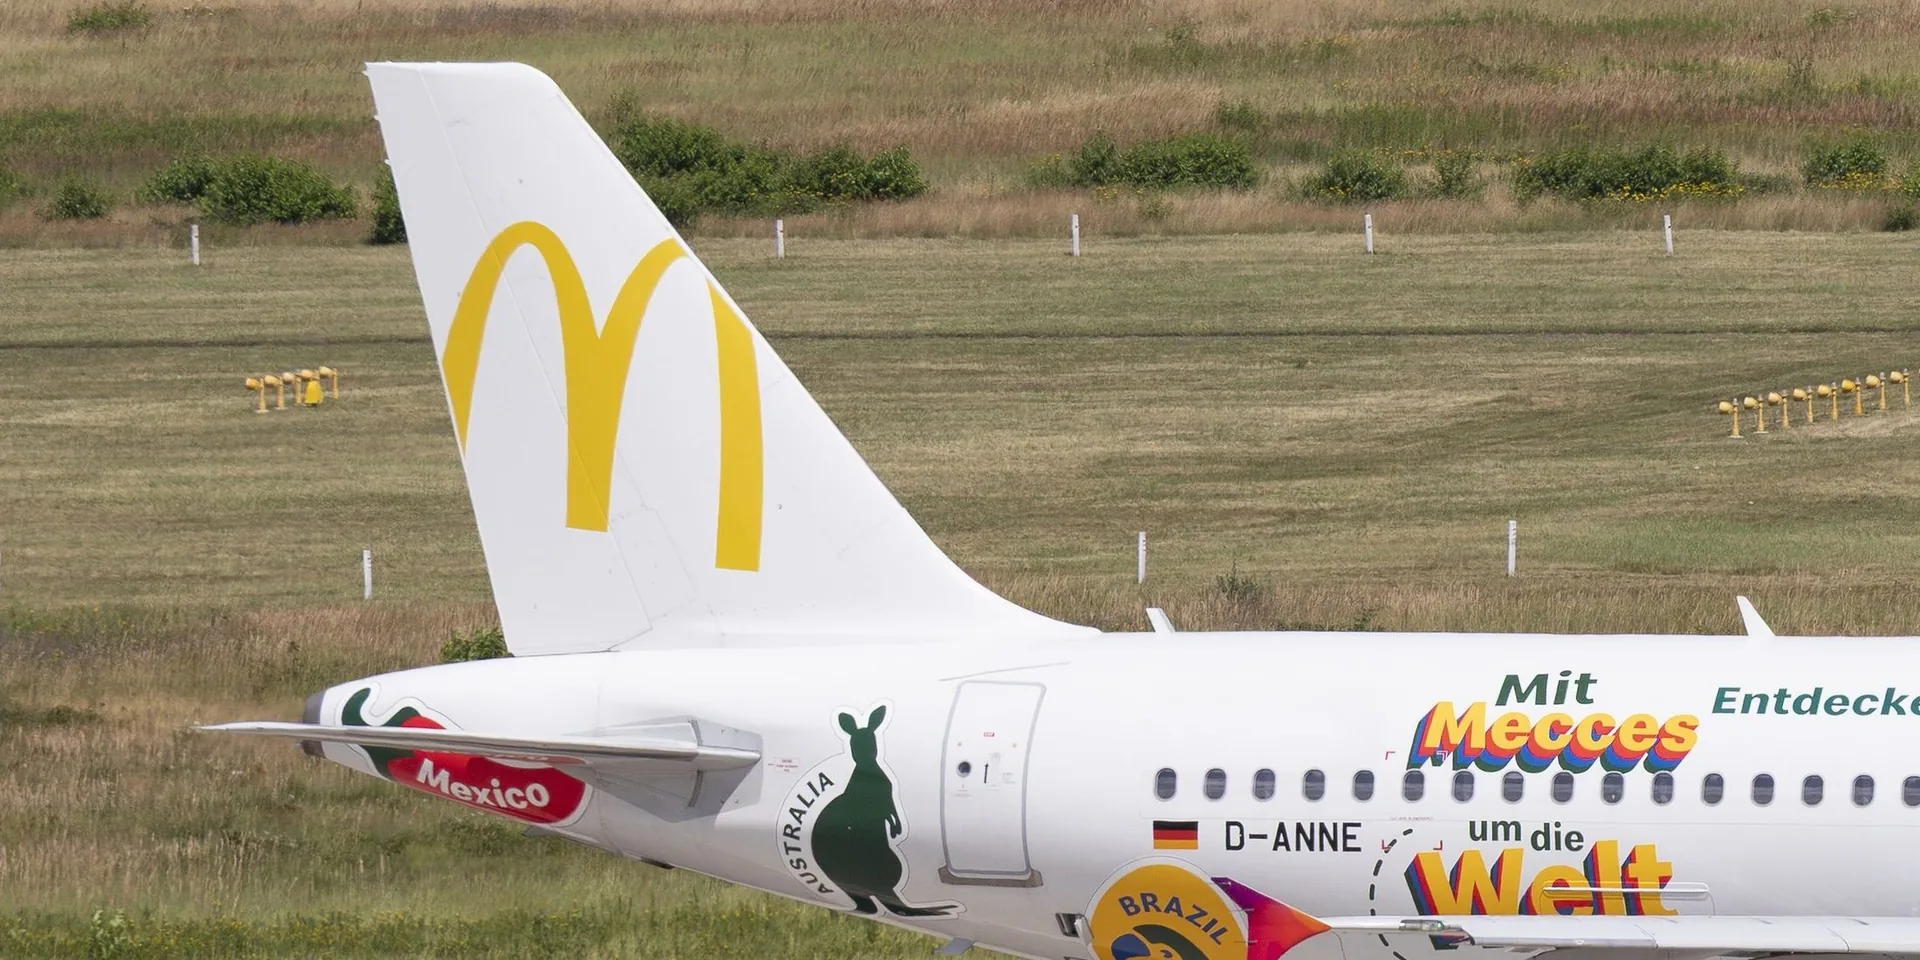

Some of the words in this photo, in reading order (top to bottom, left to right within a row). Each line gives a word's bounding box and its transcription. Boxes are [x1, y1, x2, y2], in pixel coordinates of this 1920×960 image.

[1495, 670, 1598, 706] Mit
[1406, 701, 1700, 774] Mecces
[416, 758, 550, 809] Mexico
[782, 772, 835, 894] AUSTRALIA
[1225, 821, 1362, 852] D-ANNE
[1469, 820, 1522, 841] um
[1531, 822, 1584, 851] die
[1404, 839, 1679, 916] Welt
[1118, 892, 1229, 946] BRAZIL
